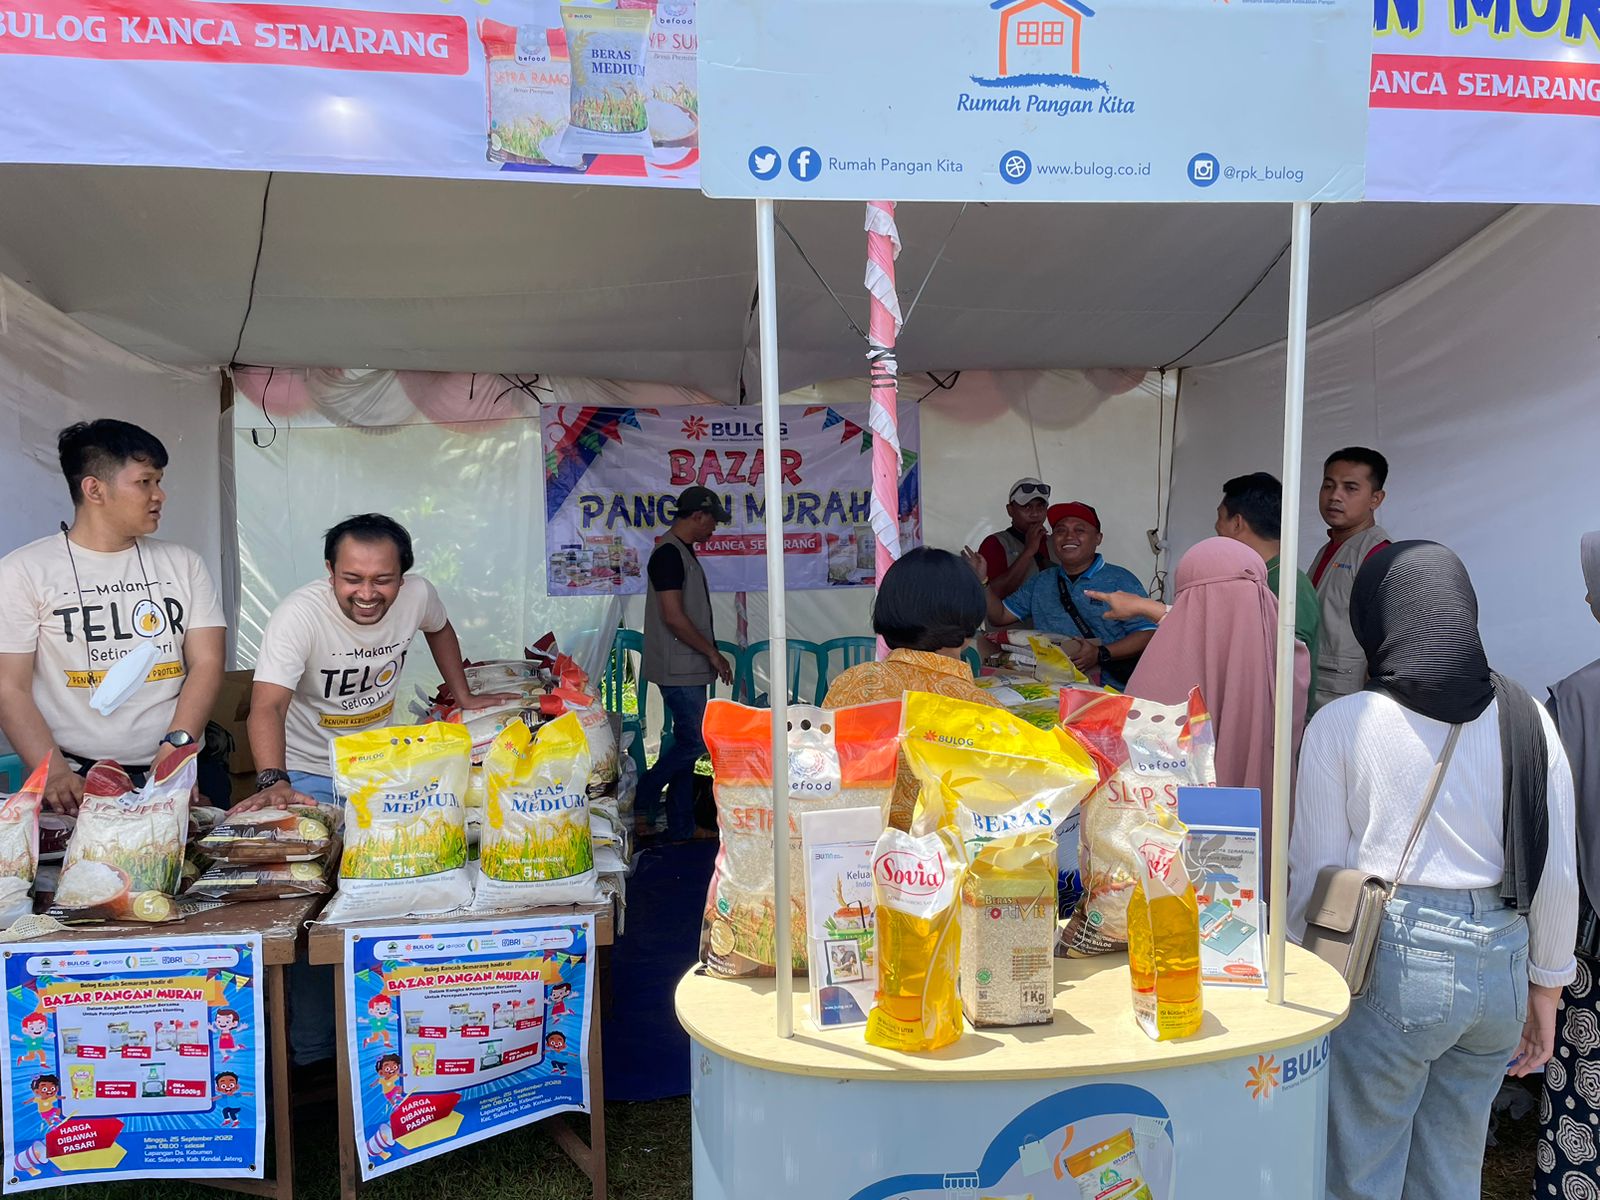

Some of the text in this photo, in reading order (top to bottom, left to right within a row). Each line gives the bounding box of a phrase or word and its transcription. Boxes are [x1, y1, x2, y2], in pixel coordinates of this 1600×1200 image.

[660, 17, 694, 25] befood
[121, 17, 242, 46] KANCA
[254, 23, 449, 58] SEMARANG
[672, 33, 698, 50] SU
[591, 49, 631, 60] BERAS
[591, 62, 646, 77] MEDIUM
[531, 71, 571, 86] RAMO
[1370, 70, 1600, 101] ANCA SEMARANG
[957, 93, 1136, 116] Rumah Pangan Kita
[829, 157, 877, 172] Rumah
[881, 158, 933, 176] Pangan
[936, 159, 964, 173] Kita
[1036, 161, 1152, 179] www.bulog.co.id
[1223, 165, 1305, 184] @rpk_bulog
[668, 449, 804, 486] BAZAR
[579, 491, 731, 529] PANG
[705, 540, 746, 551] KANCA
[750, 539, 816, 551] SERANG
[52, 597, 184, 643] TELOR
[90, 647, 133, 662] Setia
[353, 644, 393, 659] Makan
[320, 650, 408, 699] TELO
[341, 696, 376, 711] Setiap
[938, 734, 974, 746] BULOG
[1138, 758, 1187, 772] befood
[787, 781, 832, 791] efood
[1108, 780, 1156, 808] SLP
[383, 793, 460, 814] MEDIUM
[511, 793, 585, 812] MEDIUM
[972, 808, 1053, 834] BERAS
[394, 862, 416, 876] 5 kg
[523, 866, 546, 879] 5 kg
[882, 857, 942, 888] Sovia
[143, 898, 154, 915] 5
[510, 938, 521, 946] BRI
[1092, 940, 1112, 948] BULOG
[170, 956, 183, 964] BRI
[462, 962, 490, 970] Semarang
[388, 970, 540, 991] BAZAR PANGAN MURAH
[43, 988, 204, 1007] BAZAR PANGAN MURAH
[1023, 991, 1045, 1005] 1 Kg
[1282, 1035, 1330, 1084] BULO
[513, 1082, 543, 1095] September
[401, 1098, 431, 1113] HARGA
[479, 1103, 492, 1111] Jam
[479, 1105, 508, 1117] Lapangan
[400, 1105, 437, 1124] DIBAWAH
[405, 1113, 435, 1131] PASAR!
[60, 1123, 92, 1136] HARGA
[57, 1131, 98, 1146] DIBAWAH
[63, 1140, 96, 1154] PASAR!
